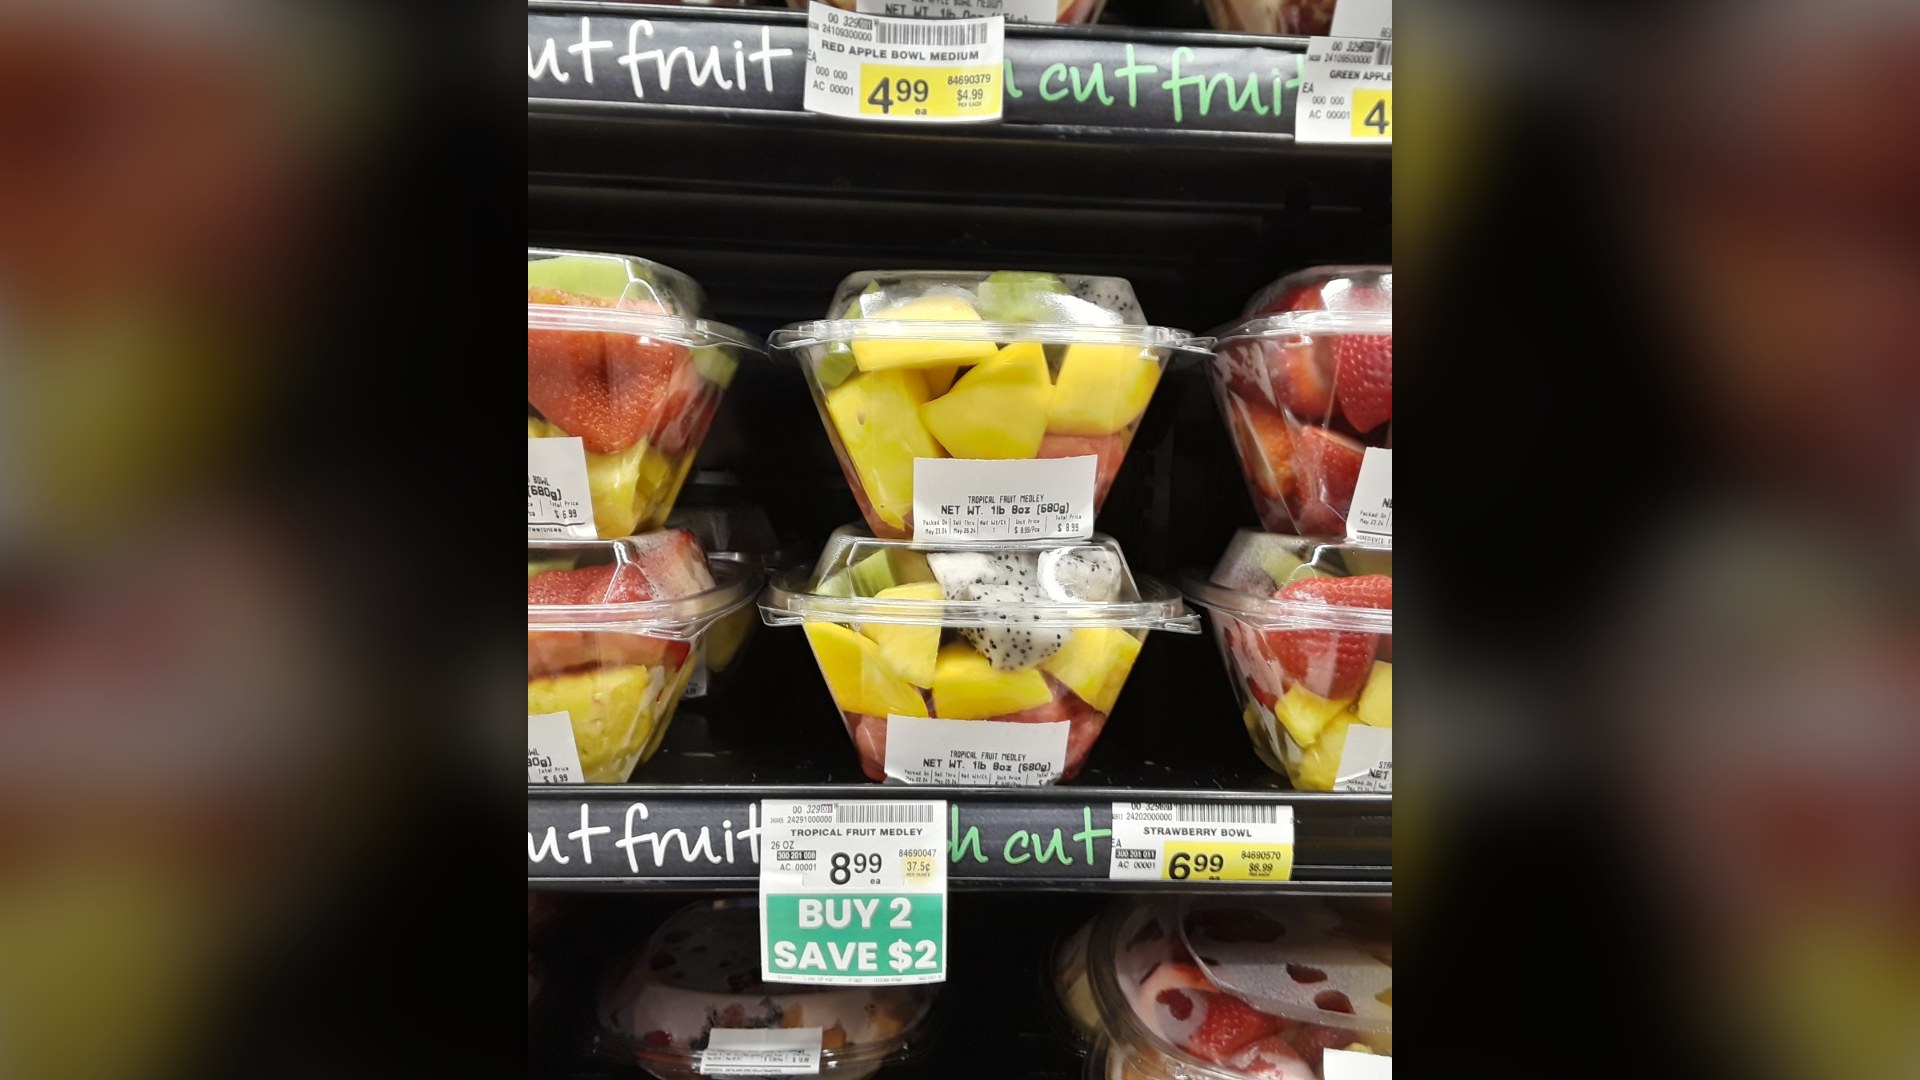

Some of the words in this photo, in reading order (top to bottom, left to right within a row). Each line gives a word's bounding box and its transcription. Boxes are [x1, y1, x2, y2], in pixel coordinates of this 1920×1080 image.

[821, 39, 845, 53] RED
[849, 45, 888, 59] APPLE
[891, 50, 926, 60] BOWL
[930, 50, 979, 61] MEDIUM
[617, 19, 793, 98] fruit
[815, 65, 829, 77] 000
[833, 69, 848, 81] 000
[1039, 44, 1158, 107] cut
[1329, 70, 1360, 80] GREEN
[947, 73, 991, 86] 84690379
[812, 79, 825, 91] AC
[829, 83, 854, 96] 00001
[1302, 82, 1314, 93] EA
[956, 88, 984, 101] $4.99
[1312, 96, 1326, 105] 000
[1330, 97, 1344, 106] 000
[914, 107, 928, 116] ea
[1308, 110, 1322, 120] AC
[1326, 111, 1351, 120] 00001
[967, 495, 996, 504] TROPICAL
[999, 495, 1017, 504] FRUIT
[1020, 494, 1045, 503] MEDLEY
[940, 505, 961, 515] NET
[967, 506, 984, 515] WT.
[990, 506, 1006, 515] 1lb
[1036, 502, 1070, 515] (680g)
[950, 750, 977, 760] TROPICAL
[980, 751, 999, 760] FRUIT
[1001, 752, 1026, 761] MEDLEY
[922, 758, 943, 769] NET
[948, 760, 966, 770] WT.
[972, 761, 987, 770] 1lb
[1018, 762, 1051, 773] (680g)
[1368, 768, 1390, 780] NET
[793, 806, 803, 814] 00
[1126, 812, 1173, 821] 24202000000
[790, 828, 843, 836] TROPICAL
[846, 828, 876, 836] FRUIT
[880, 828, 923, 836] MEDLEY
[1003, 805, 1112, 866] cut
[1143, 827, 1217, 837] STRAWBERRY
[1221, 828, 1252, 837] BOWL
[615, 803, 762, 873] fruit
[771, 841, 781, 850] 26
[783, 841, 795, 850] OZ
[777, 852, 789, 860] 300
[899, 849, 937, 858] 84690047
[780, 863, 791, 871] AC
[795, 863, 817, 871] 00001
[906, 861, 931, 873] 37.5¢
[1117, 861, 1129, 869] AC
[1134, 861, 1156, 869] 00001
[1248, 863, 1273, 872] $6.99
[799, 898, 880, 929] BUY
[889, 897, 913, 929] 2
[774, 940, 878, 972] SAVE
[888, 938, 937, 972] $2
